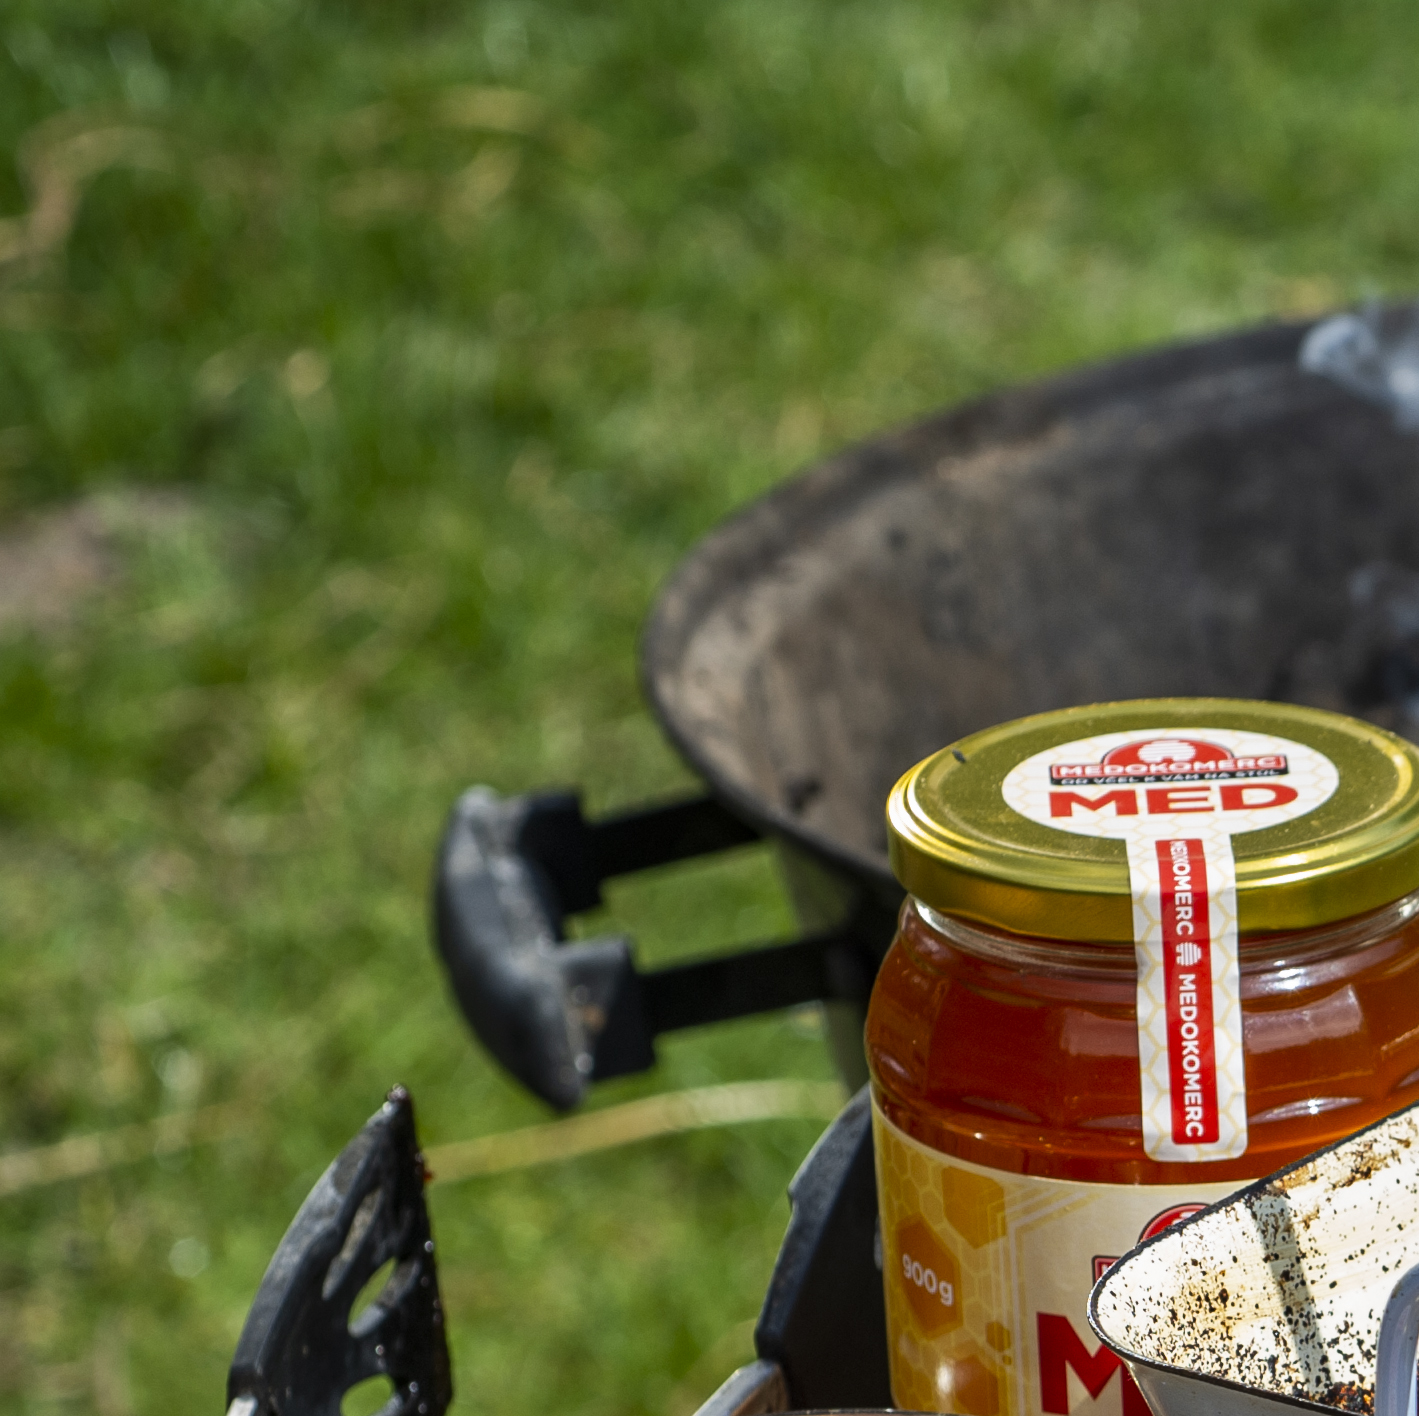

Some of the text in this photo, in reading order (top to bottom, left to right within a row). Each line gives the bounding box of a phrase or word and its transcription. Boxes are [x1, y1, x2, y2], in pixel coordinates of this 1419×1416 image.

[1059, 756, 1278, 777] MEDOKOMERC
[1048, 783, 1298, 817] MED
[1179, 973, 1205, 1137] MEDOKOMERC
